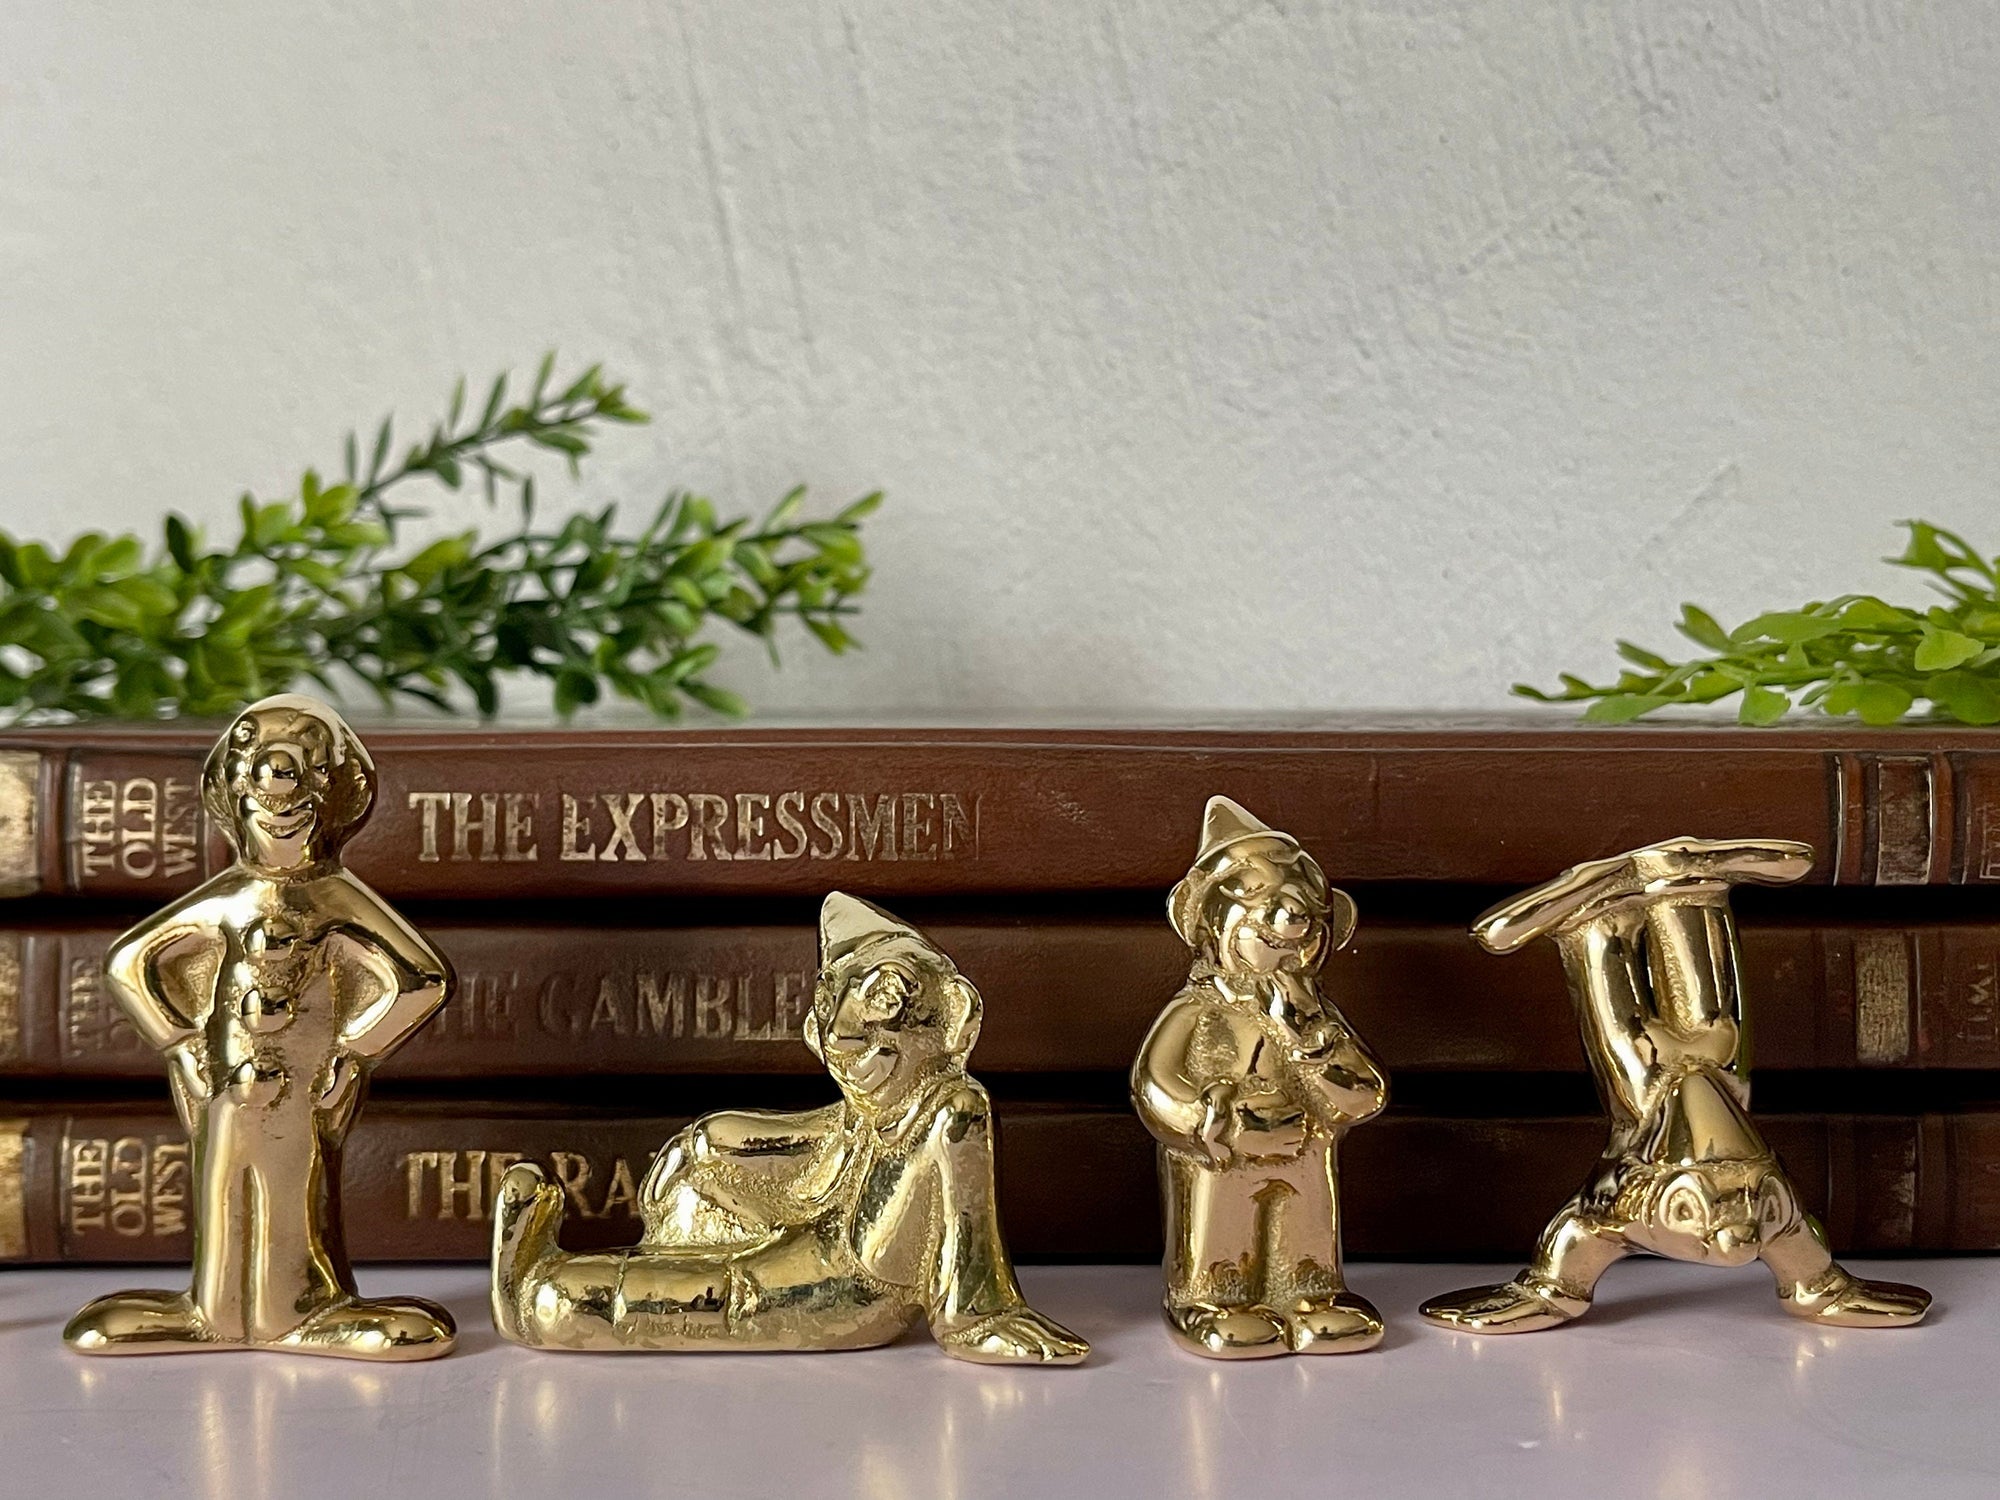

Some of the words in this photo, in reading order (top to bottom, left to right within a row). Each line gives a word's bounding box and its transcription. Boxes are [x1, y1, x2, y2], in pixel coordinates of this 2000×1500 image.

[82, 779, 117, 877] THE
[121, 777, 158, 880] OLD
[162, 776, 199, 879] WEST
[408, 791, 539, 862] THE
[558, 791, 981, 862] EXPRESSMEN
[71, 1138, 109, 1236] THE
[110, 1136, 147, 1237] OLD
